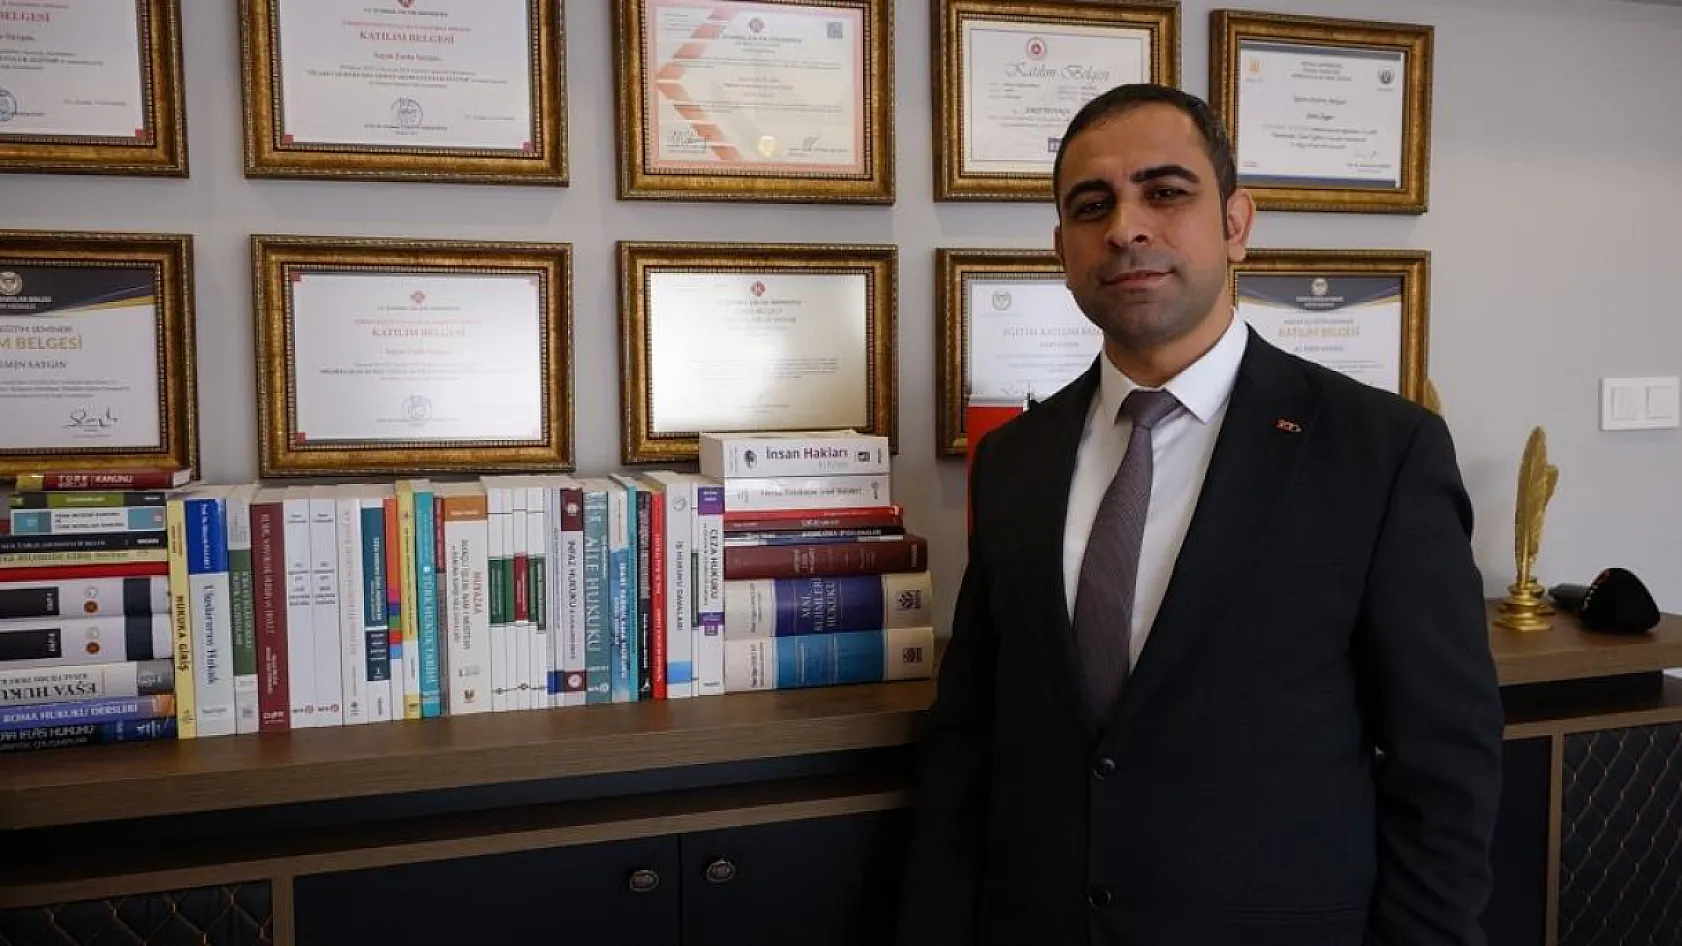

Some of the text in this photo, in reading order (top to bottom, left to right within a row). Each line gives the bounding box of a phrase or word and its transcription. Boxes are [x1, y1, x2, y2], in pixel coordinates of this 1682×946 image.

[15, 334, 82, 349] BELGESİ
[766, 446, 849, 460] İnsan Hakları
[709, 529, 719, 600] CEZA HUKUKU
[568, 568, 577, 608] HUKUKU
[585, 536, 601, 652] AİLE HUKUKU
